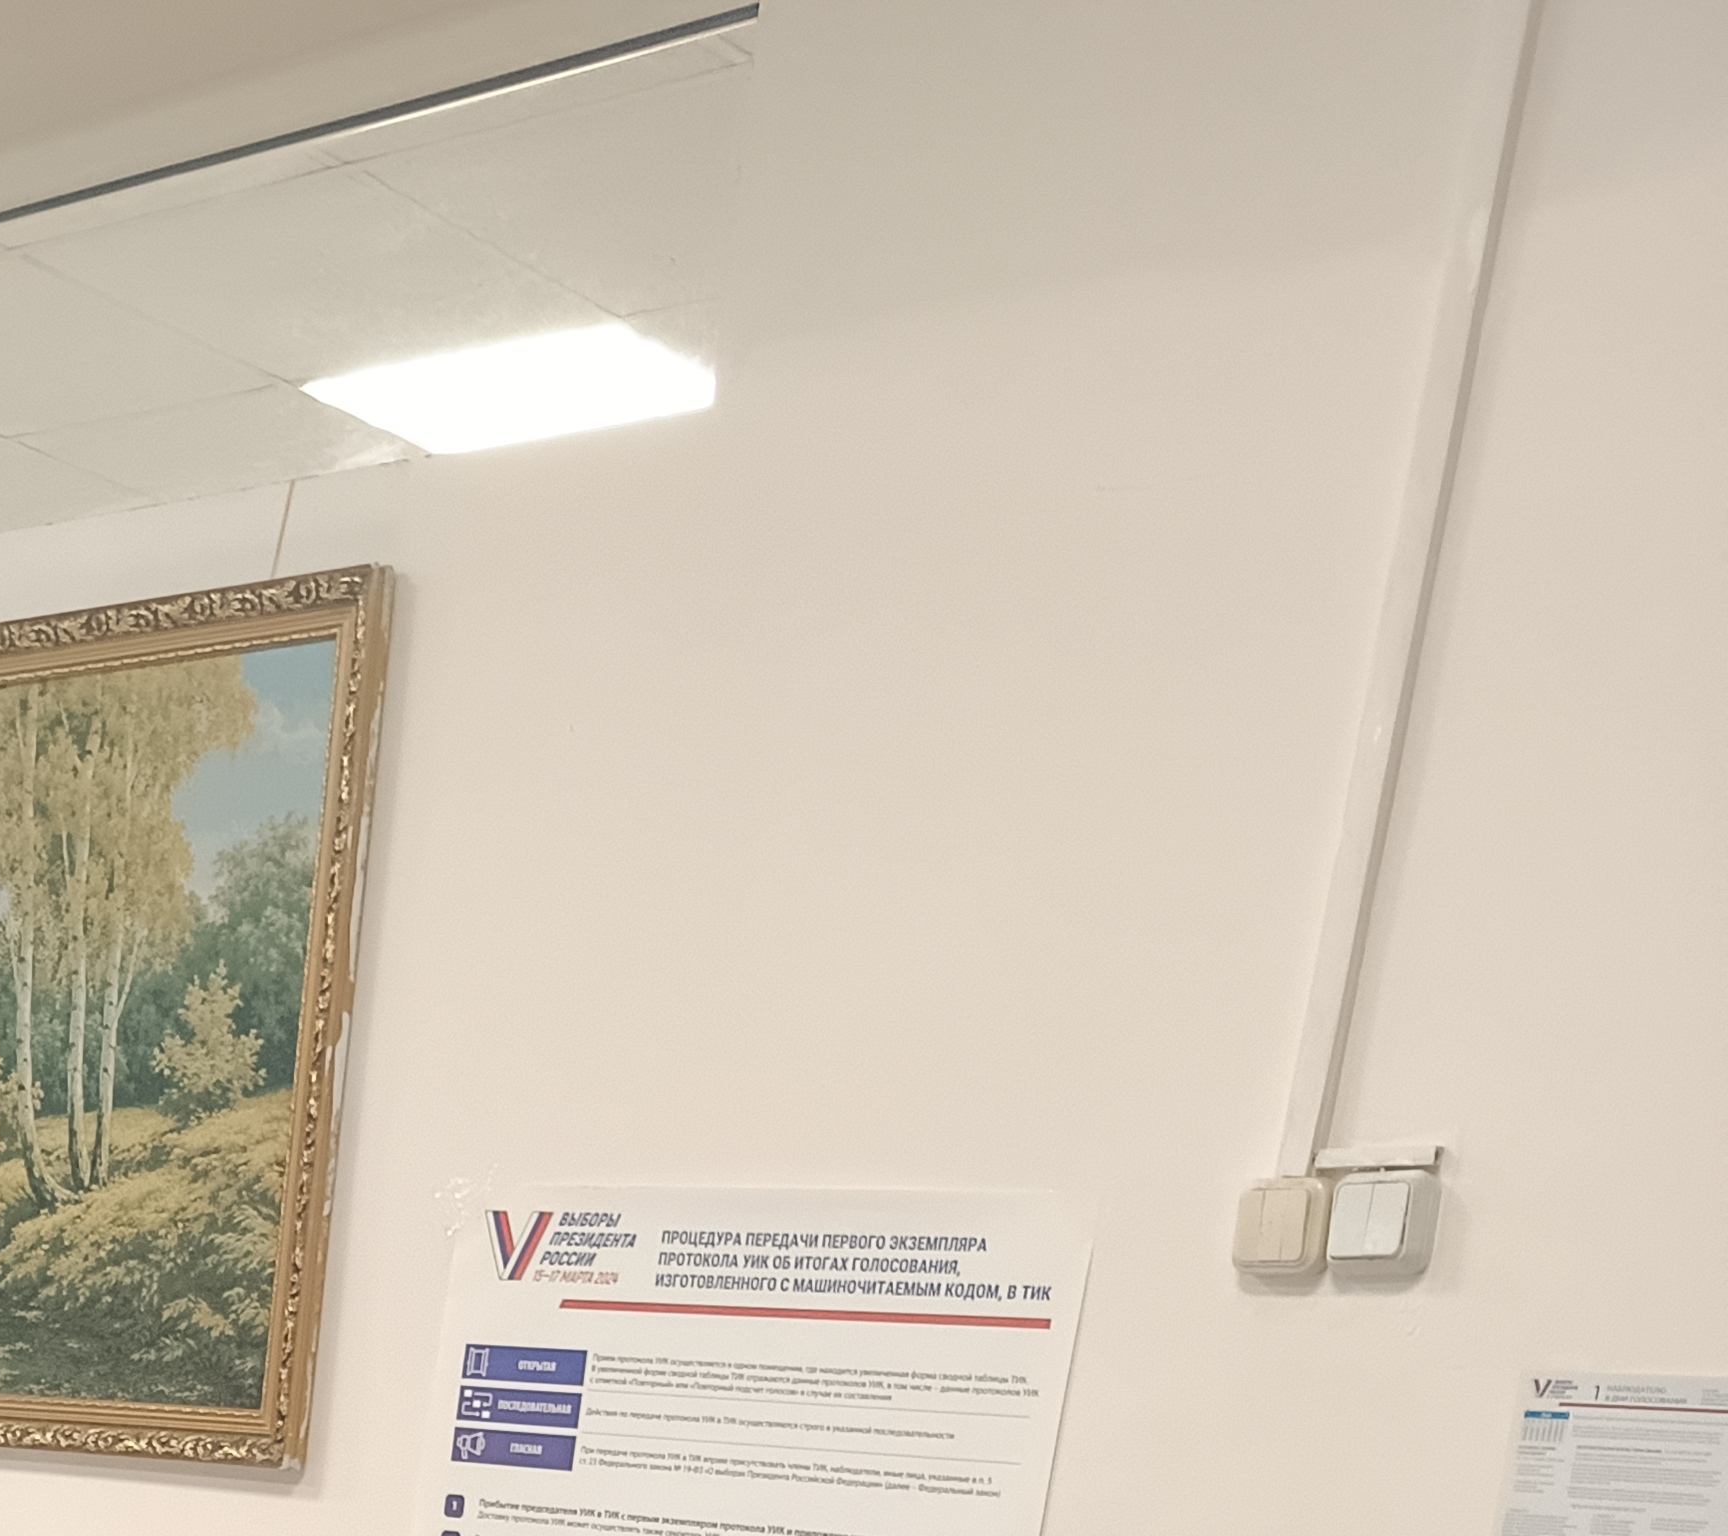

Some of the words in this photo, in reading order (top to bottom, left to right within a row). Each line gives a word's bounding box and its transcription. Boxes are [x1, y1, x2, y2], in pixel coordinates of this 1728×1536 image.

[559, 1212, 621, 1227] ВЫБОРЫ
[549, 1231, 637, 1249] ПРЕЗИДЕНТА
[661, 1230, 743, 1248] ПРОЦЕДУРА
[744, 1232, 819, 1250] ПЕРЕДАЧИ
[820, 1234, 886, 1249] ПЕРВОГО
[888, 1236, 988, 1252] ЭКЗЕМПЛЯРА
[539, 1251, 597, 1266] РОССИИ
[657, 1252, 739, 1267] ПРОТОКОЛА
[741, 1254, 770, 1268] УИК
[771, 1255, 792, 1269] ОБ
[793, 1255, 849, 1271] ИТОГАХ
[850, 1257, 962, 1274] ГОЛОСОВАНИЯ,
[559, 1270, 594, 1283] МАРТА
[593, 1272, 620, 1285] 2024
[654, 1273, 777, 1291] ИЗГОТОВЛЕННОГО
[791, 1277, 941, 1296] МАШИНОЧИТАЕМЫМ
[943, 1282, 1004, 1301] КОДОМ,
[1020, 1285, 1052, 1300] ТИК
